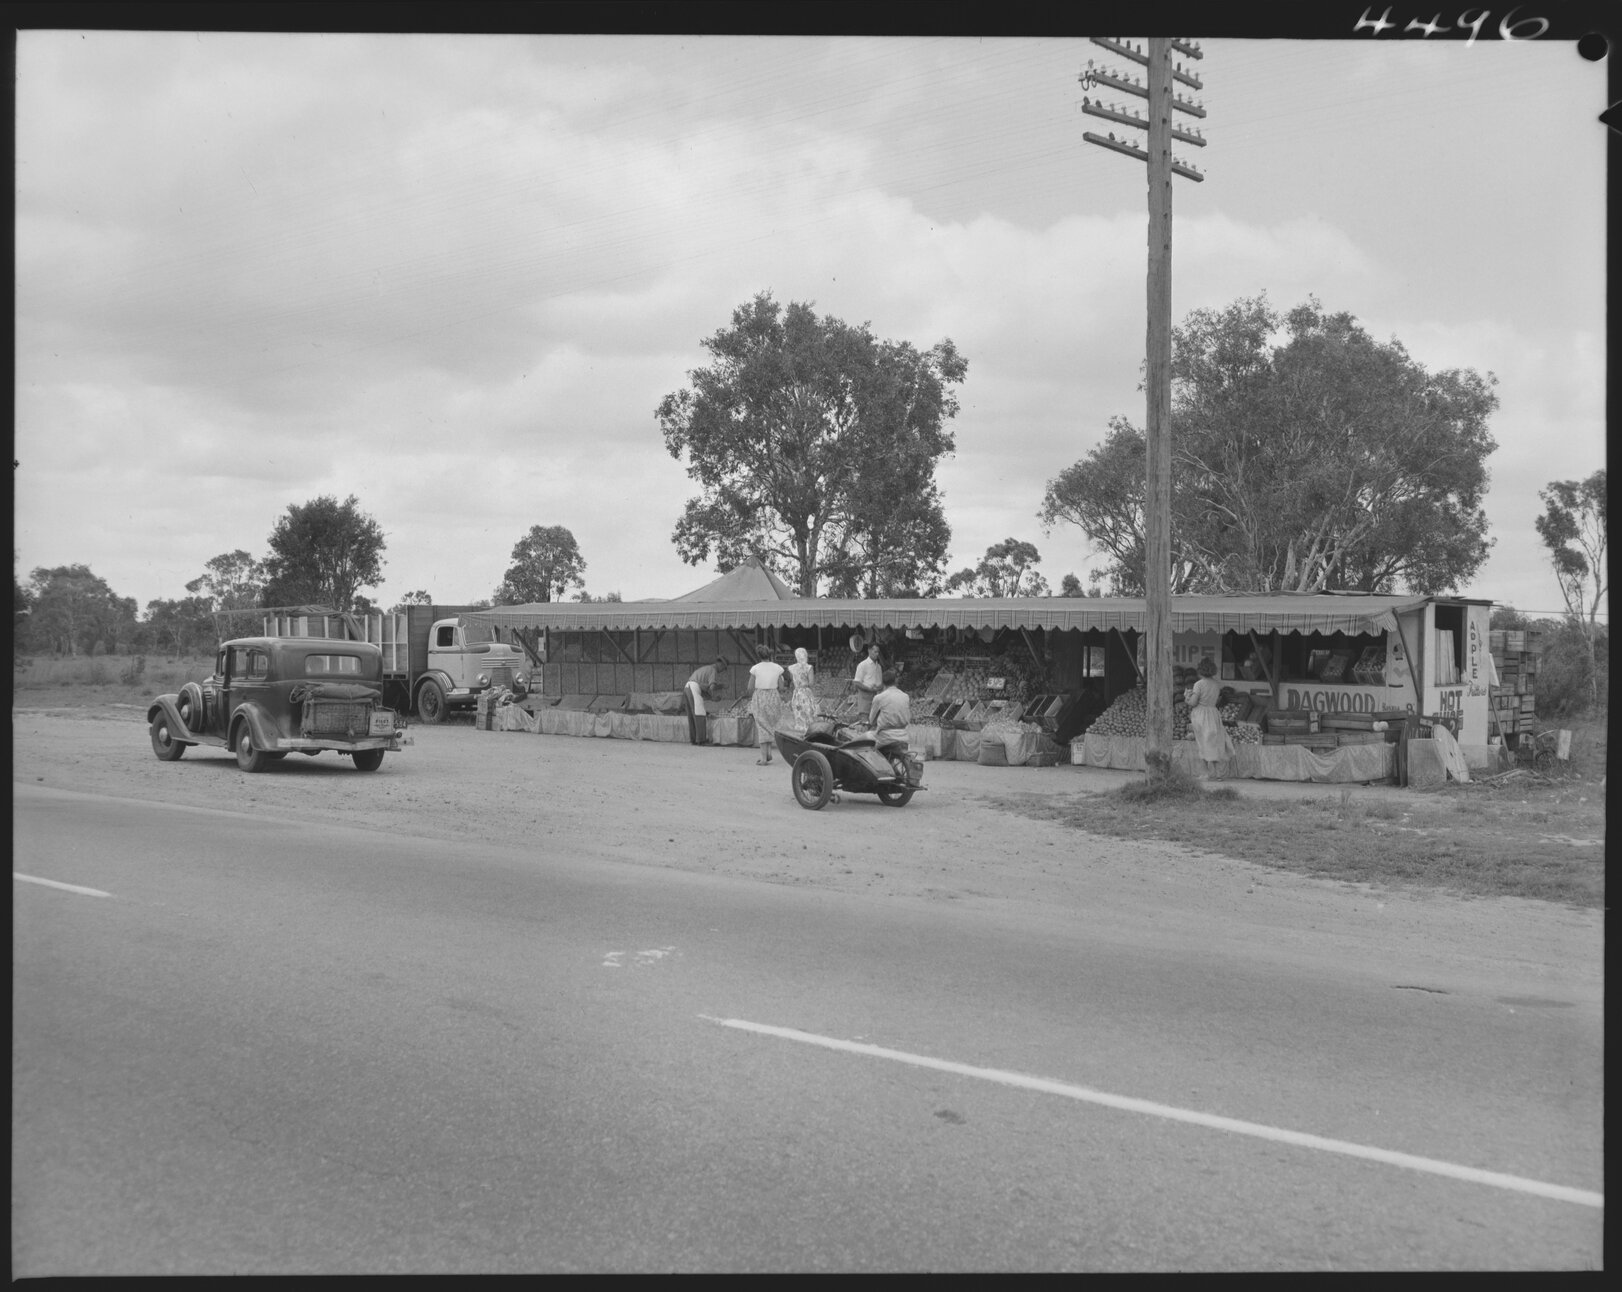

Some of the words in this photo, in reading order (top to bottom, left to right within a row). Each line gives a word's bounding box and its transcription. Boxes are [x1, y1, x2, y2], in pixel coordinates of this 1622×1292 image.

[1353, 5, 1549, 48] 4496
[1287, 688, 1376, 713] DAGWOOD
[1440, 690, 1463, 711] HOT
